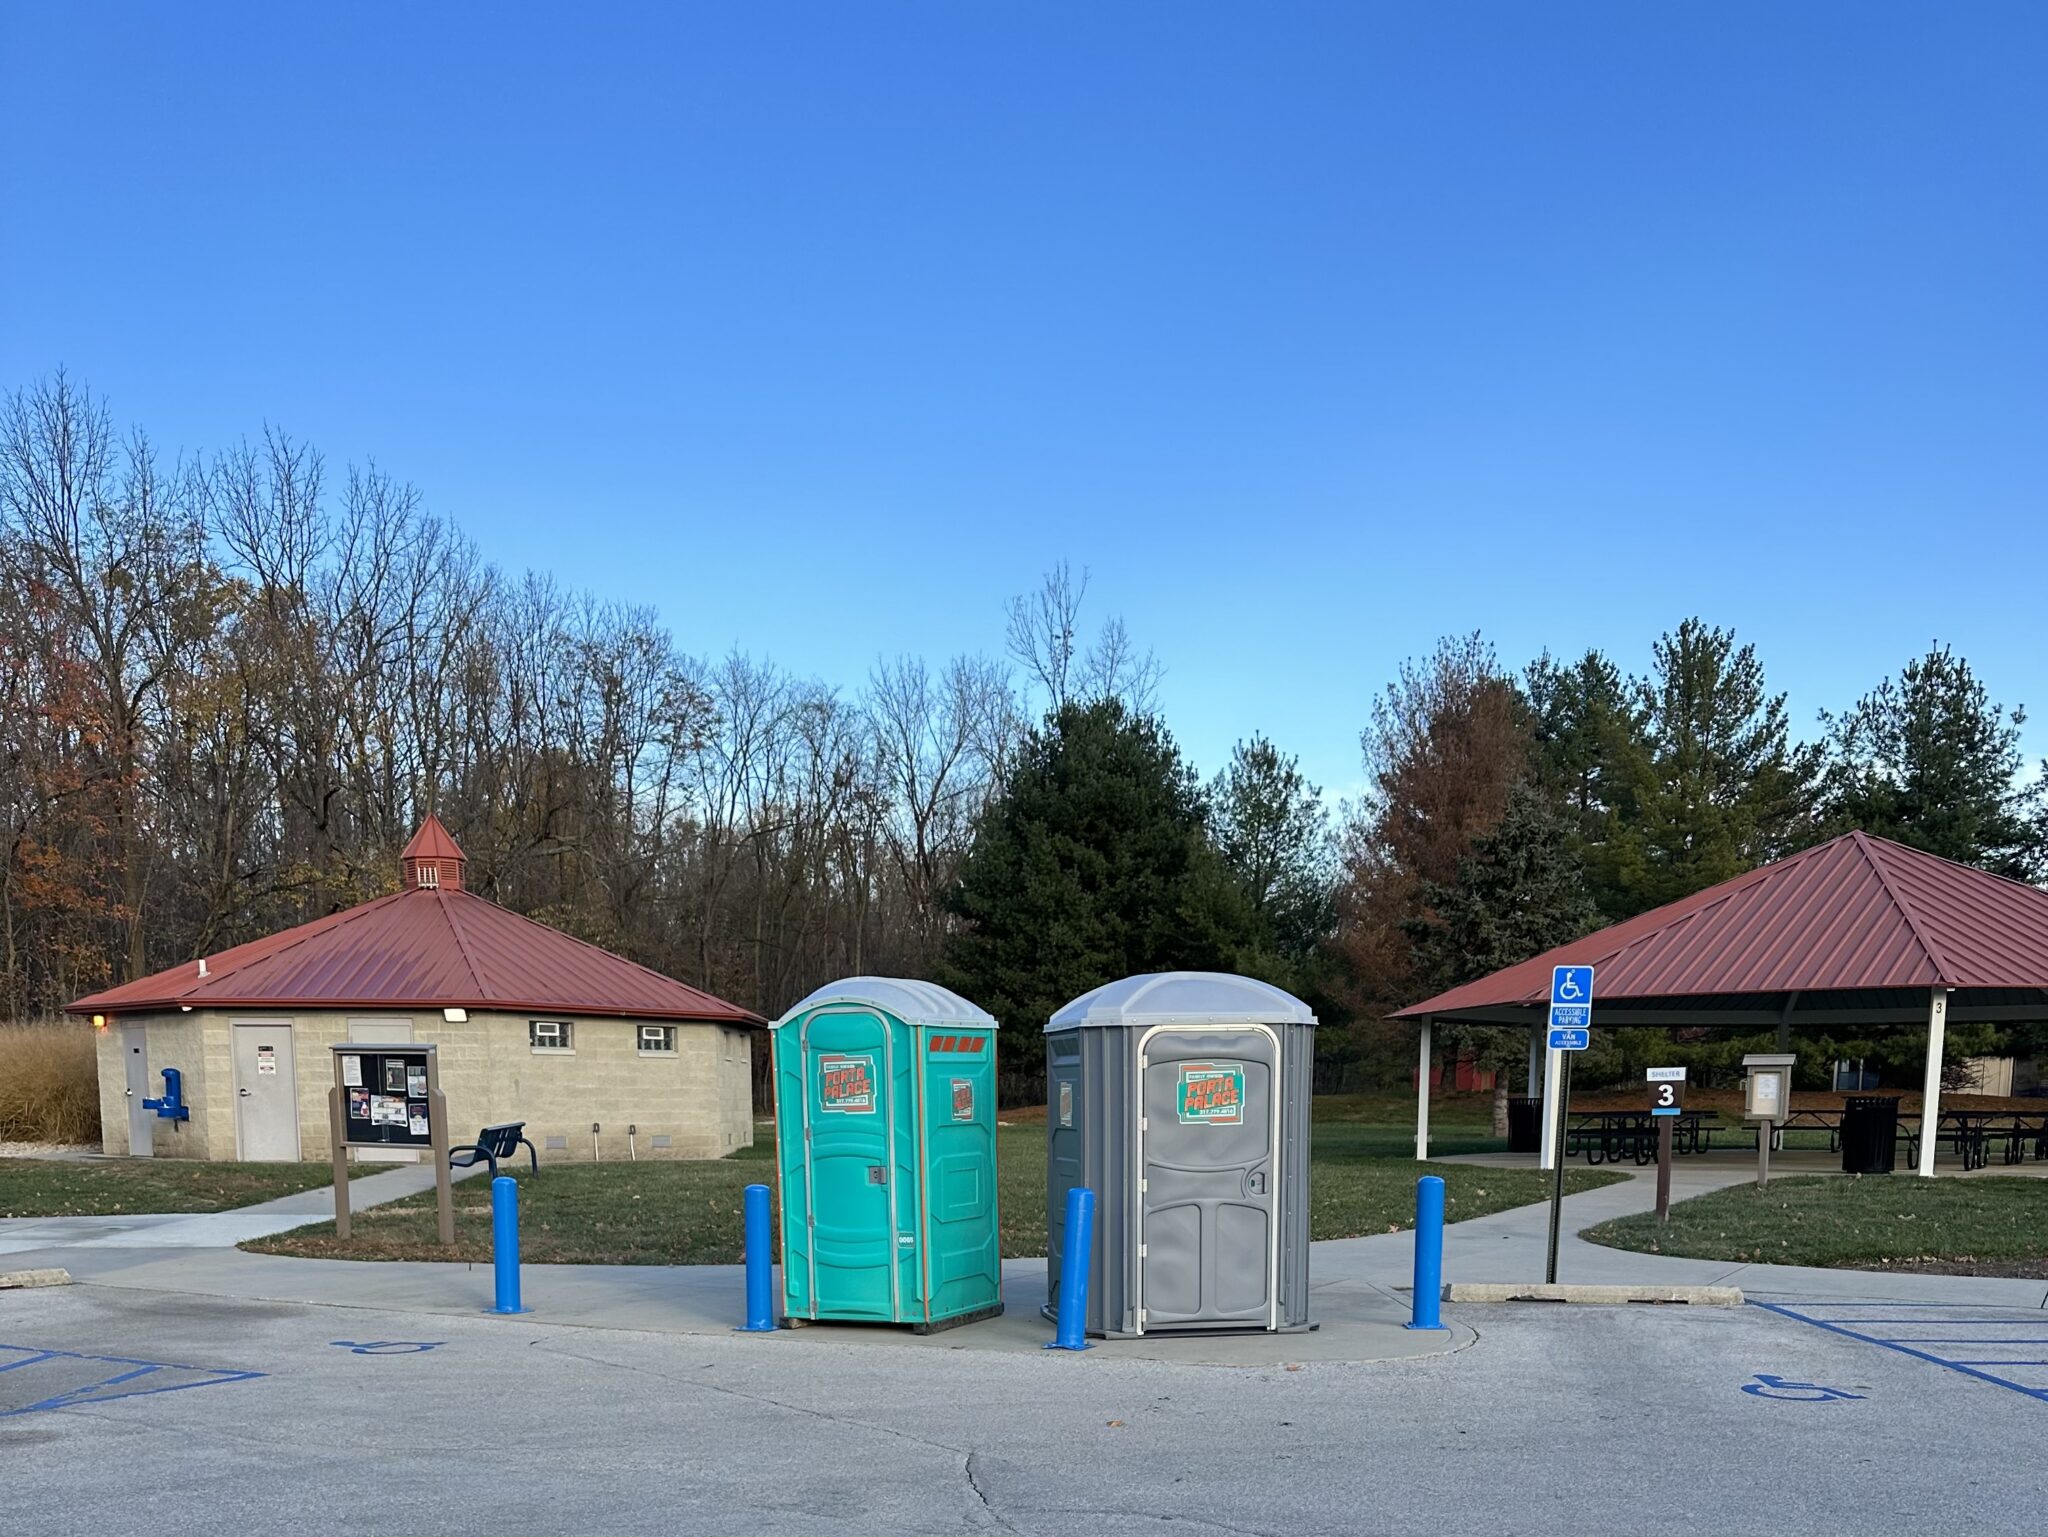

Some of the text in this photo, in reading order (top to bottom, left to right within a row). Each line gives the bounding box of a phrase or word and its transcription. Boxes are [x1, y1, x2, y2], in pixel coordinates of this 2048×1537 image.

[1555, 1008, 1587, 1017] ACCESSIBLE
[1936, 1002, 1942, 1014] 3
[1558, 1015, 1582, 1025] PARKING
[825, 1067, 865, 1087] PORTA
[1188, 1077, 1234, 1097] PORTA
[824, 1079, 871, 1100] PALACE
[1657, 1084, 1674, 1106] 3
[1185, 1089, 1239, 1111] PALACE
